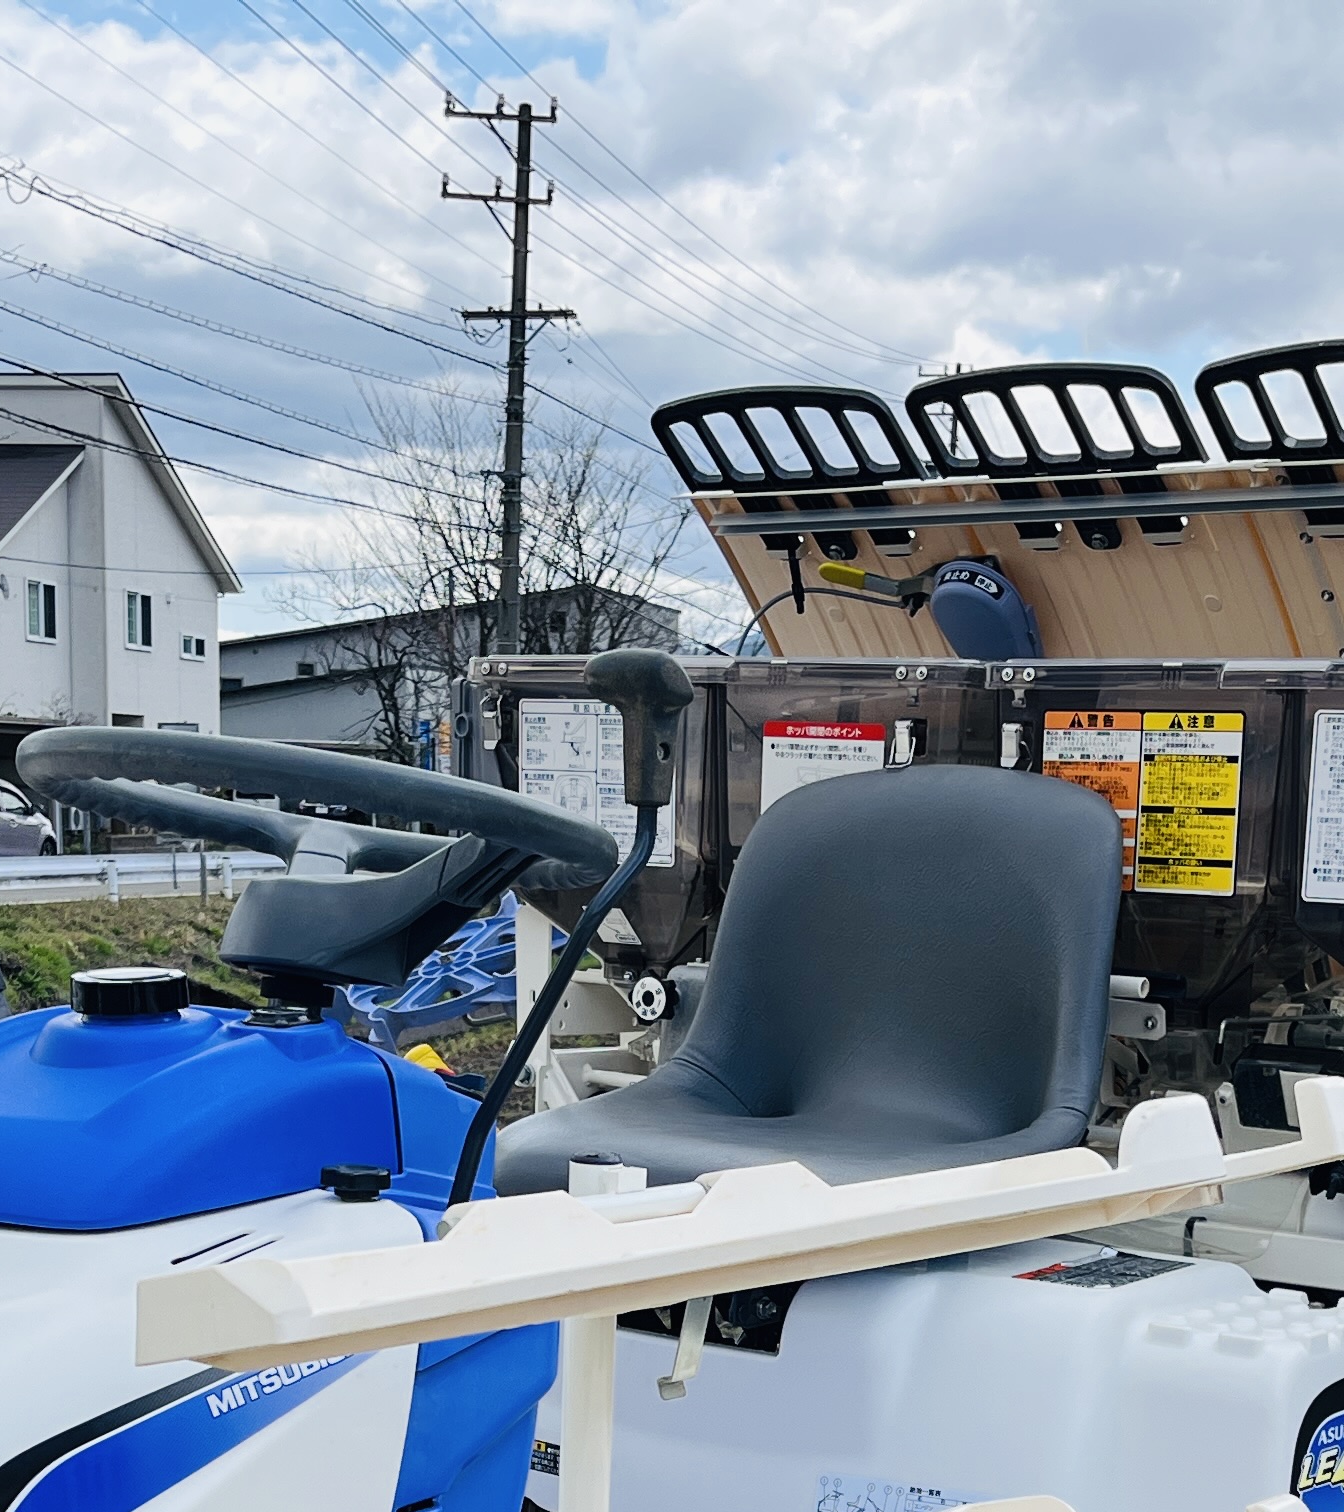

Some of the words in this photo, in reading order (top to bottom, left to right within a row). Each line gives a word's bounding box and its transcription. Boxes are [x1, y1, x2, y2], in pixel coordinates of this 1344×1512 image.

[1087, 714, 1115, 728] 警告
[1187, 715, 1215, 729] 注意
[207, 1354, 354, 1419] MITSUB
